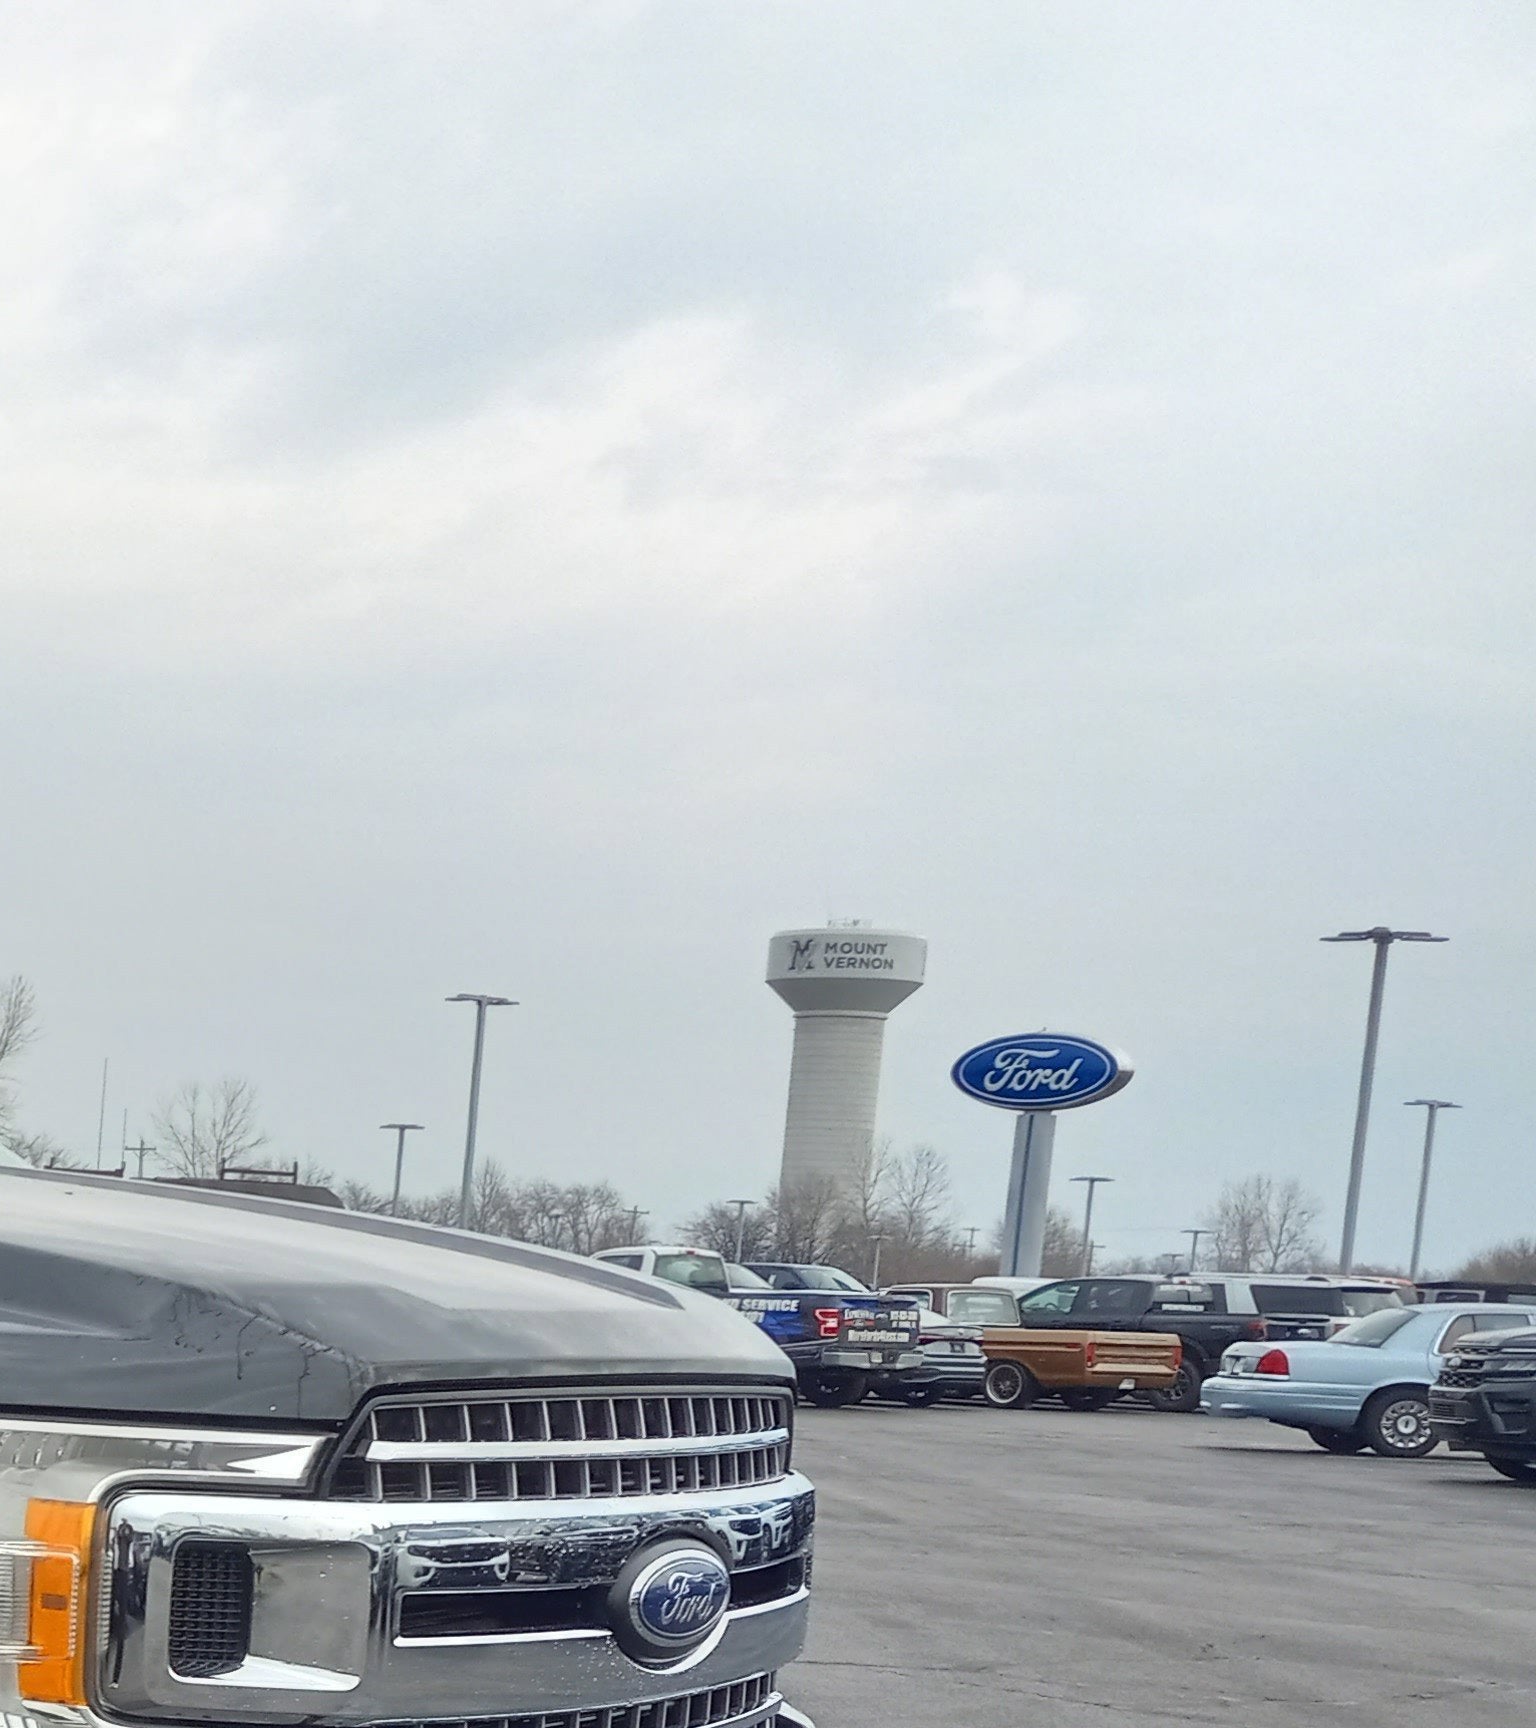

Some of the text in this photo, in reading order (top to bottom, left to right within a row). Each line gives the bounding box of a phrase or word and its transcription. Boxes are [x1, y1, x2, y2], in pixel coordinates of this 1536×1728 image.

[825, 942, 888, 955] MOUNT
[824, 957, 894, 969] VERNON
[983, 1048, 1084, 1092] Ford
[741, 1298, 801, 1312] SERVICE
[660, 1572, 717, 1626] Ford
